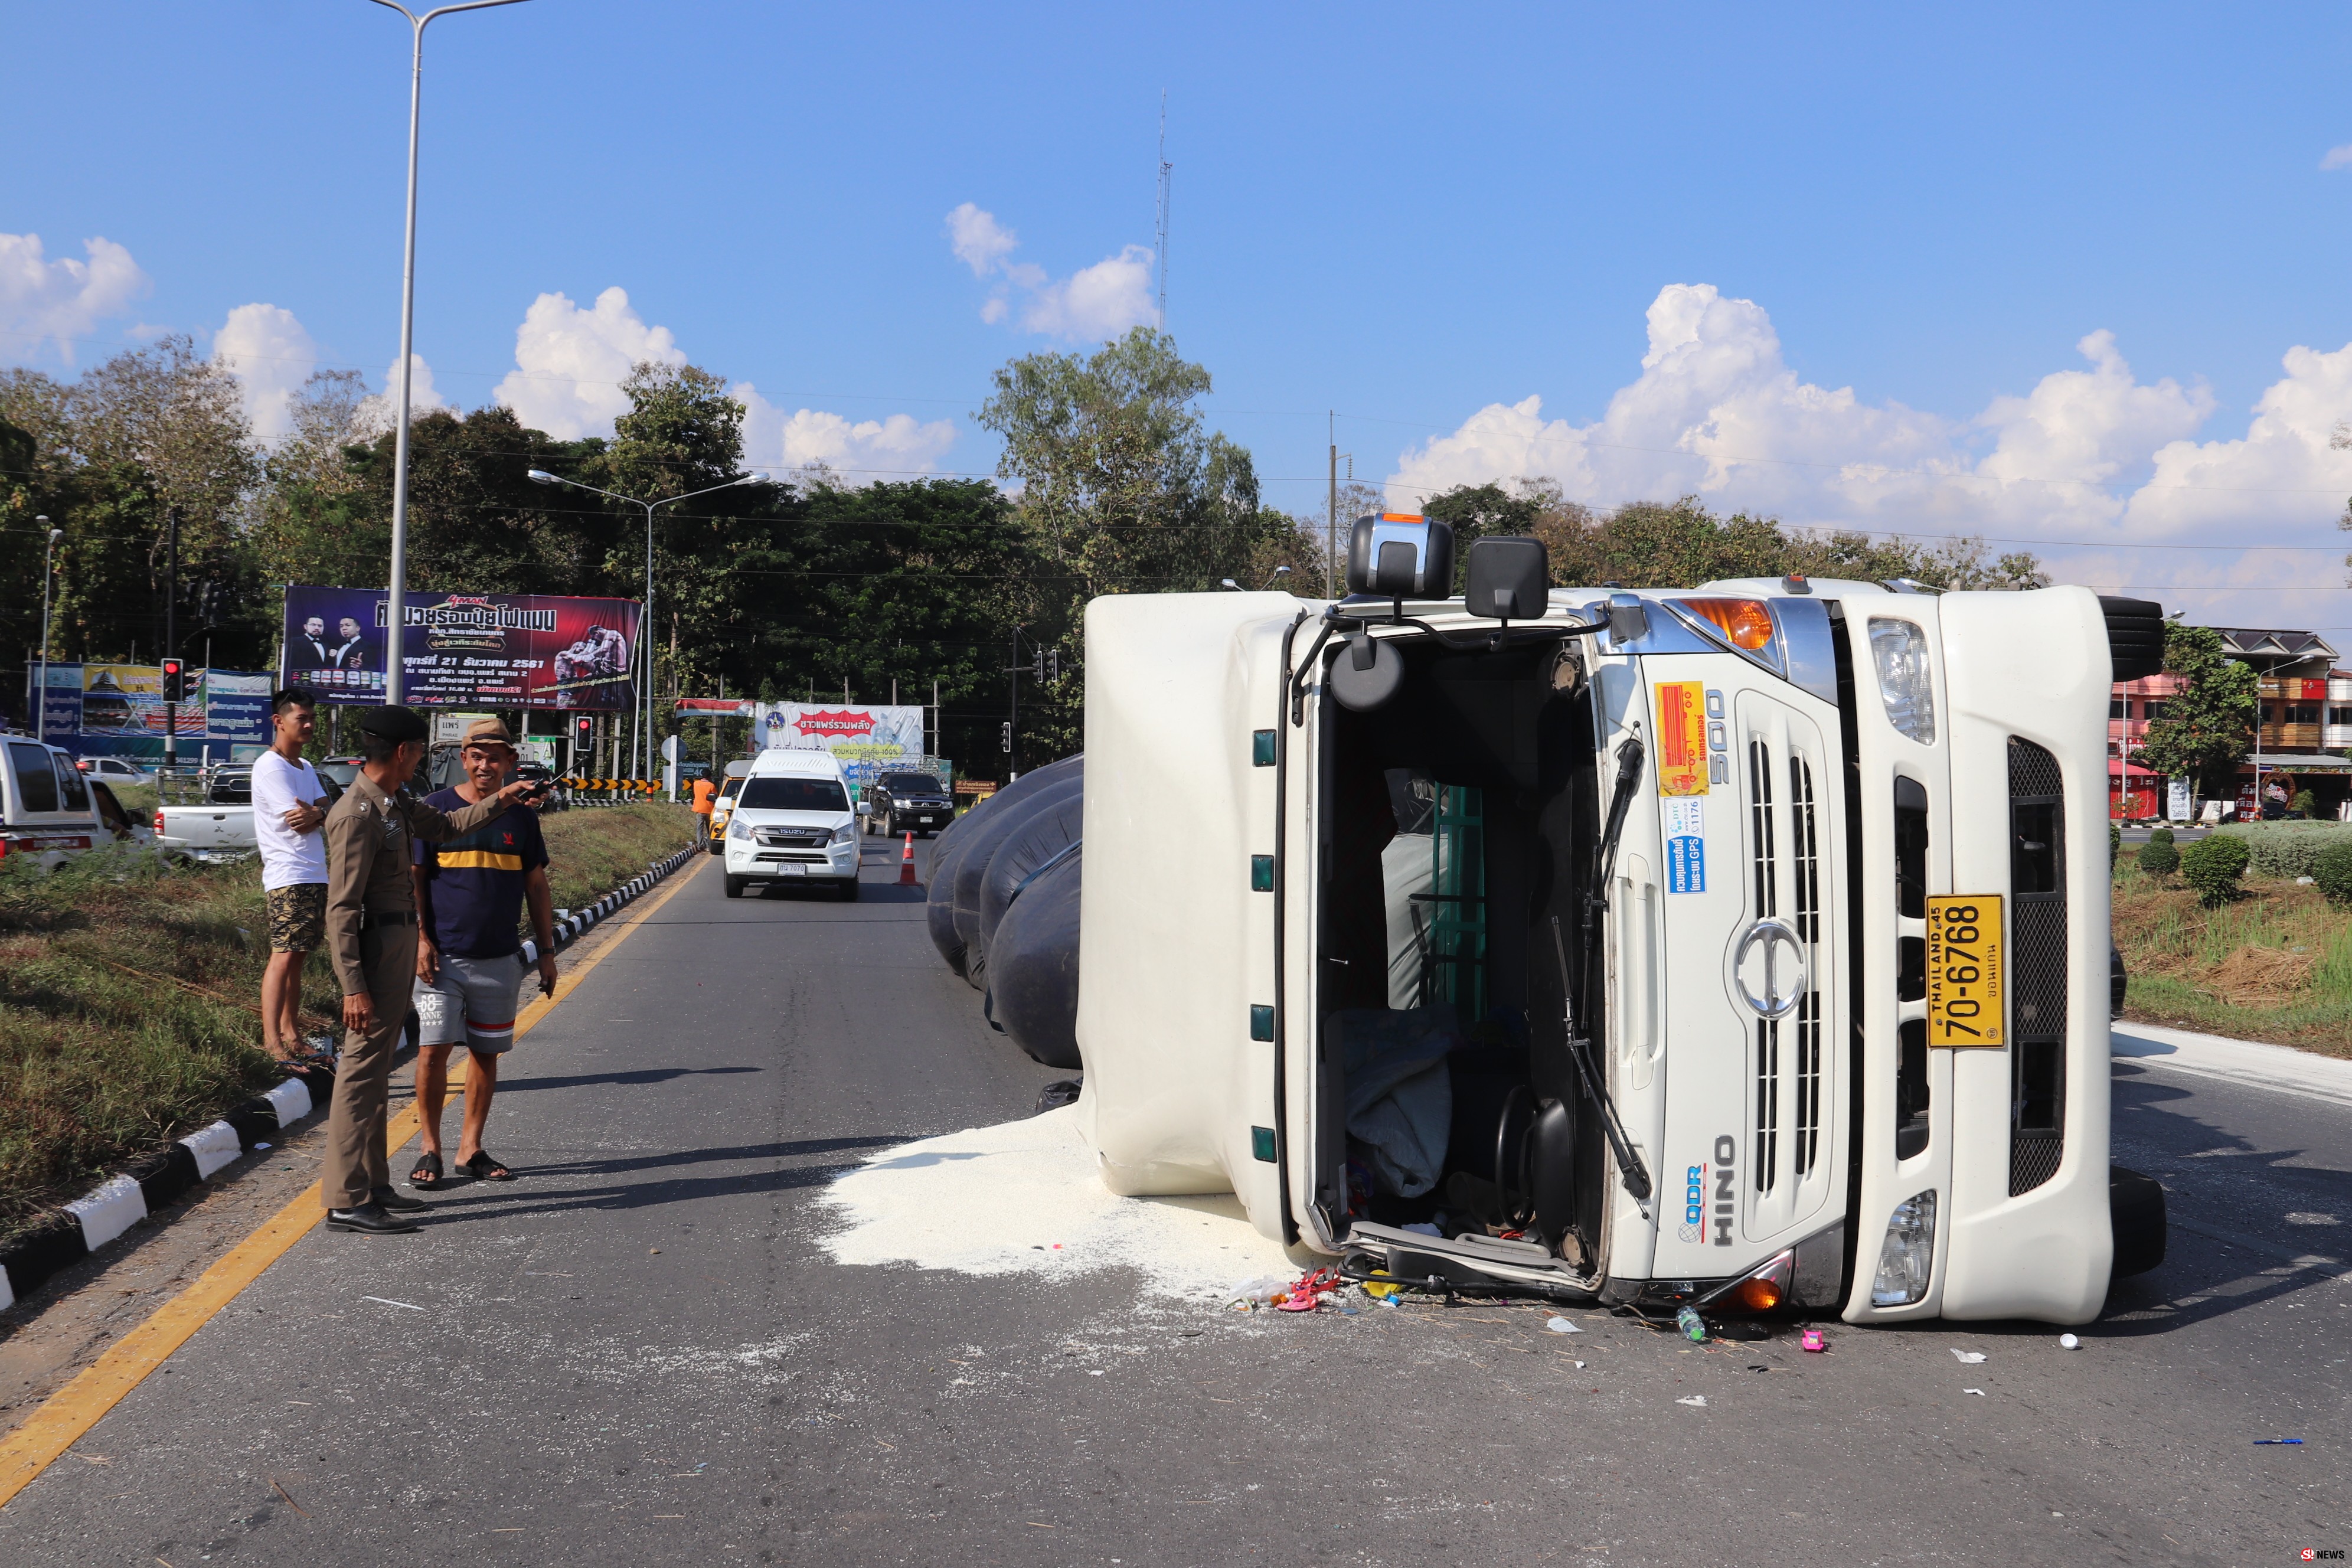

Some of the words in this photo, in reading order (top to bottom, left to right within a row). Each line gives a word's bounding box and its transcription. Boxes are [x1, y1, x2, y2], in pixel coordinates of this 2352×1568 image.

[445, 594, 489, 609] 4MAN
[441, 656, 458, 667] 21
[463, 656, 508, 668] ธันวาคม
[512, 659, 544, 669] 2561
[442, 720, 459, 729] แพร่
[801, 718, 871, 730] ชาวแพร่รวมพลัง
[1694, 714, 1706, 762] รถเทรลเลอร์
[1706, 688, 1729, 785] 500
[1690, 801, 1699, 825] 1176
[1671, 838, 1687, 892] ควบคุมการขับขี่
[1689, 838, 1700, 859] GPS
[1690, 860, 1701, 891] โดยระบบ
[1930, 932, 1942, 1012] THAILAND
[1945, 906, 1981, 1037] 70-6768
[1984, 944, 1997, 998] ขอนแก่น
[1686, 1165, 1702, 1224] QDR
[1713, 1134, 1736, 1247] HINO
